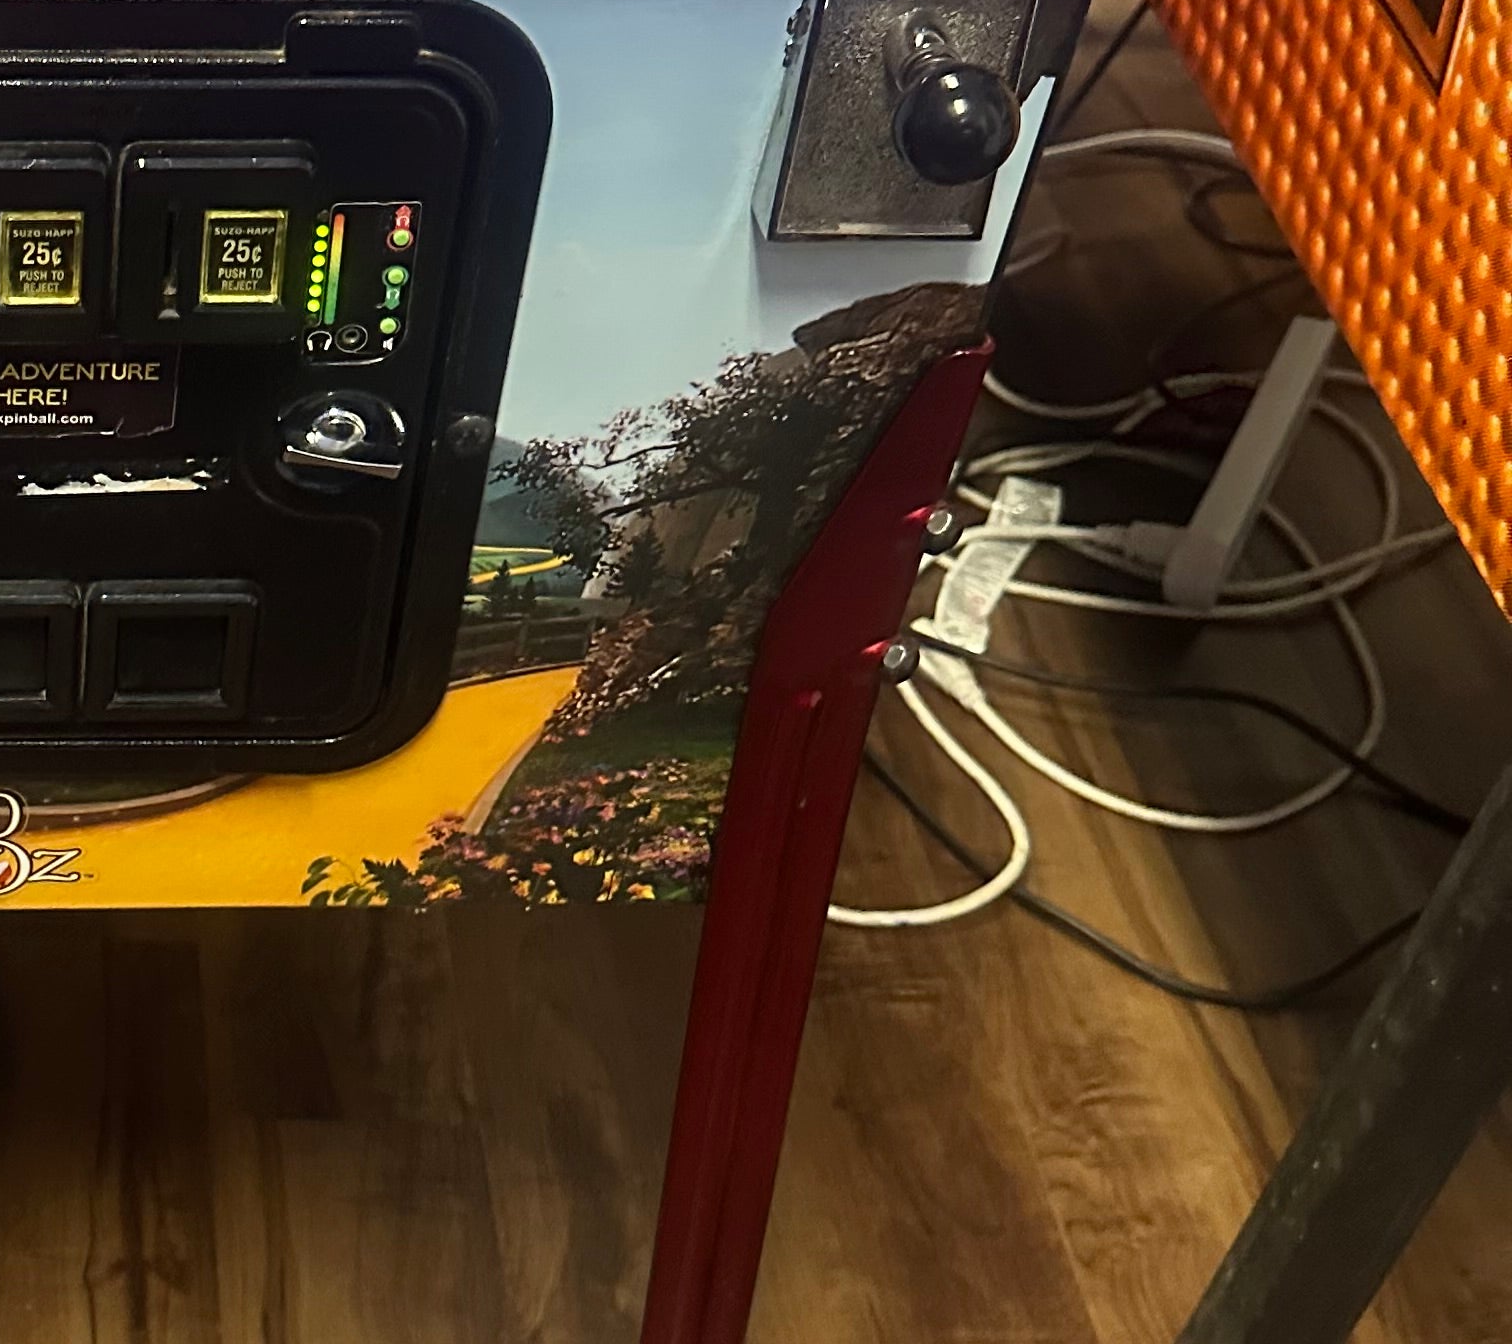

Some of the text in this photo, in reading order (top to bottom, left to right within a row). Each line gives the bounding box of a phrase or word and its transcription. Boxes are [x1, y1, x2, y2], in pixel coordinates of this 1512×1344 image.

[22, 241, 62, 268] 25¢
[221, 239, 262, 264] 25¢
[19, 270, 65, 282] PUSH TO
[217, 267, 264, 280] PUSH TO
[23, 282, 61, 294] REJECT
[221, 279, 258, 291] REJECT
[0, 362, 161, 381] ADVENTURE
